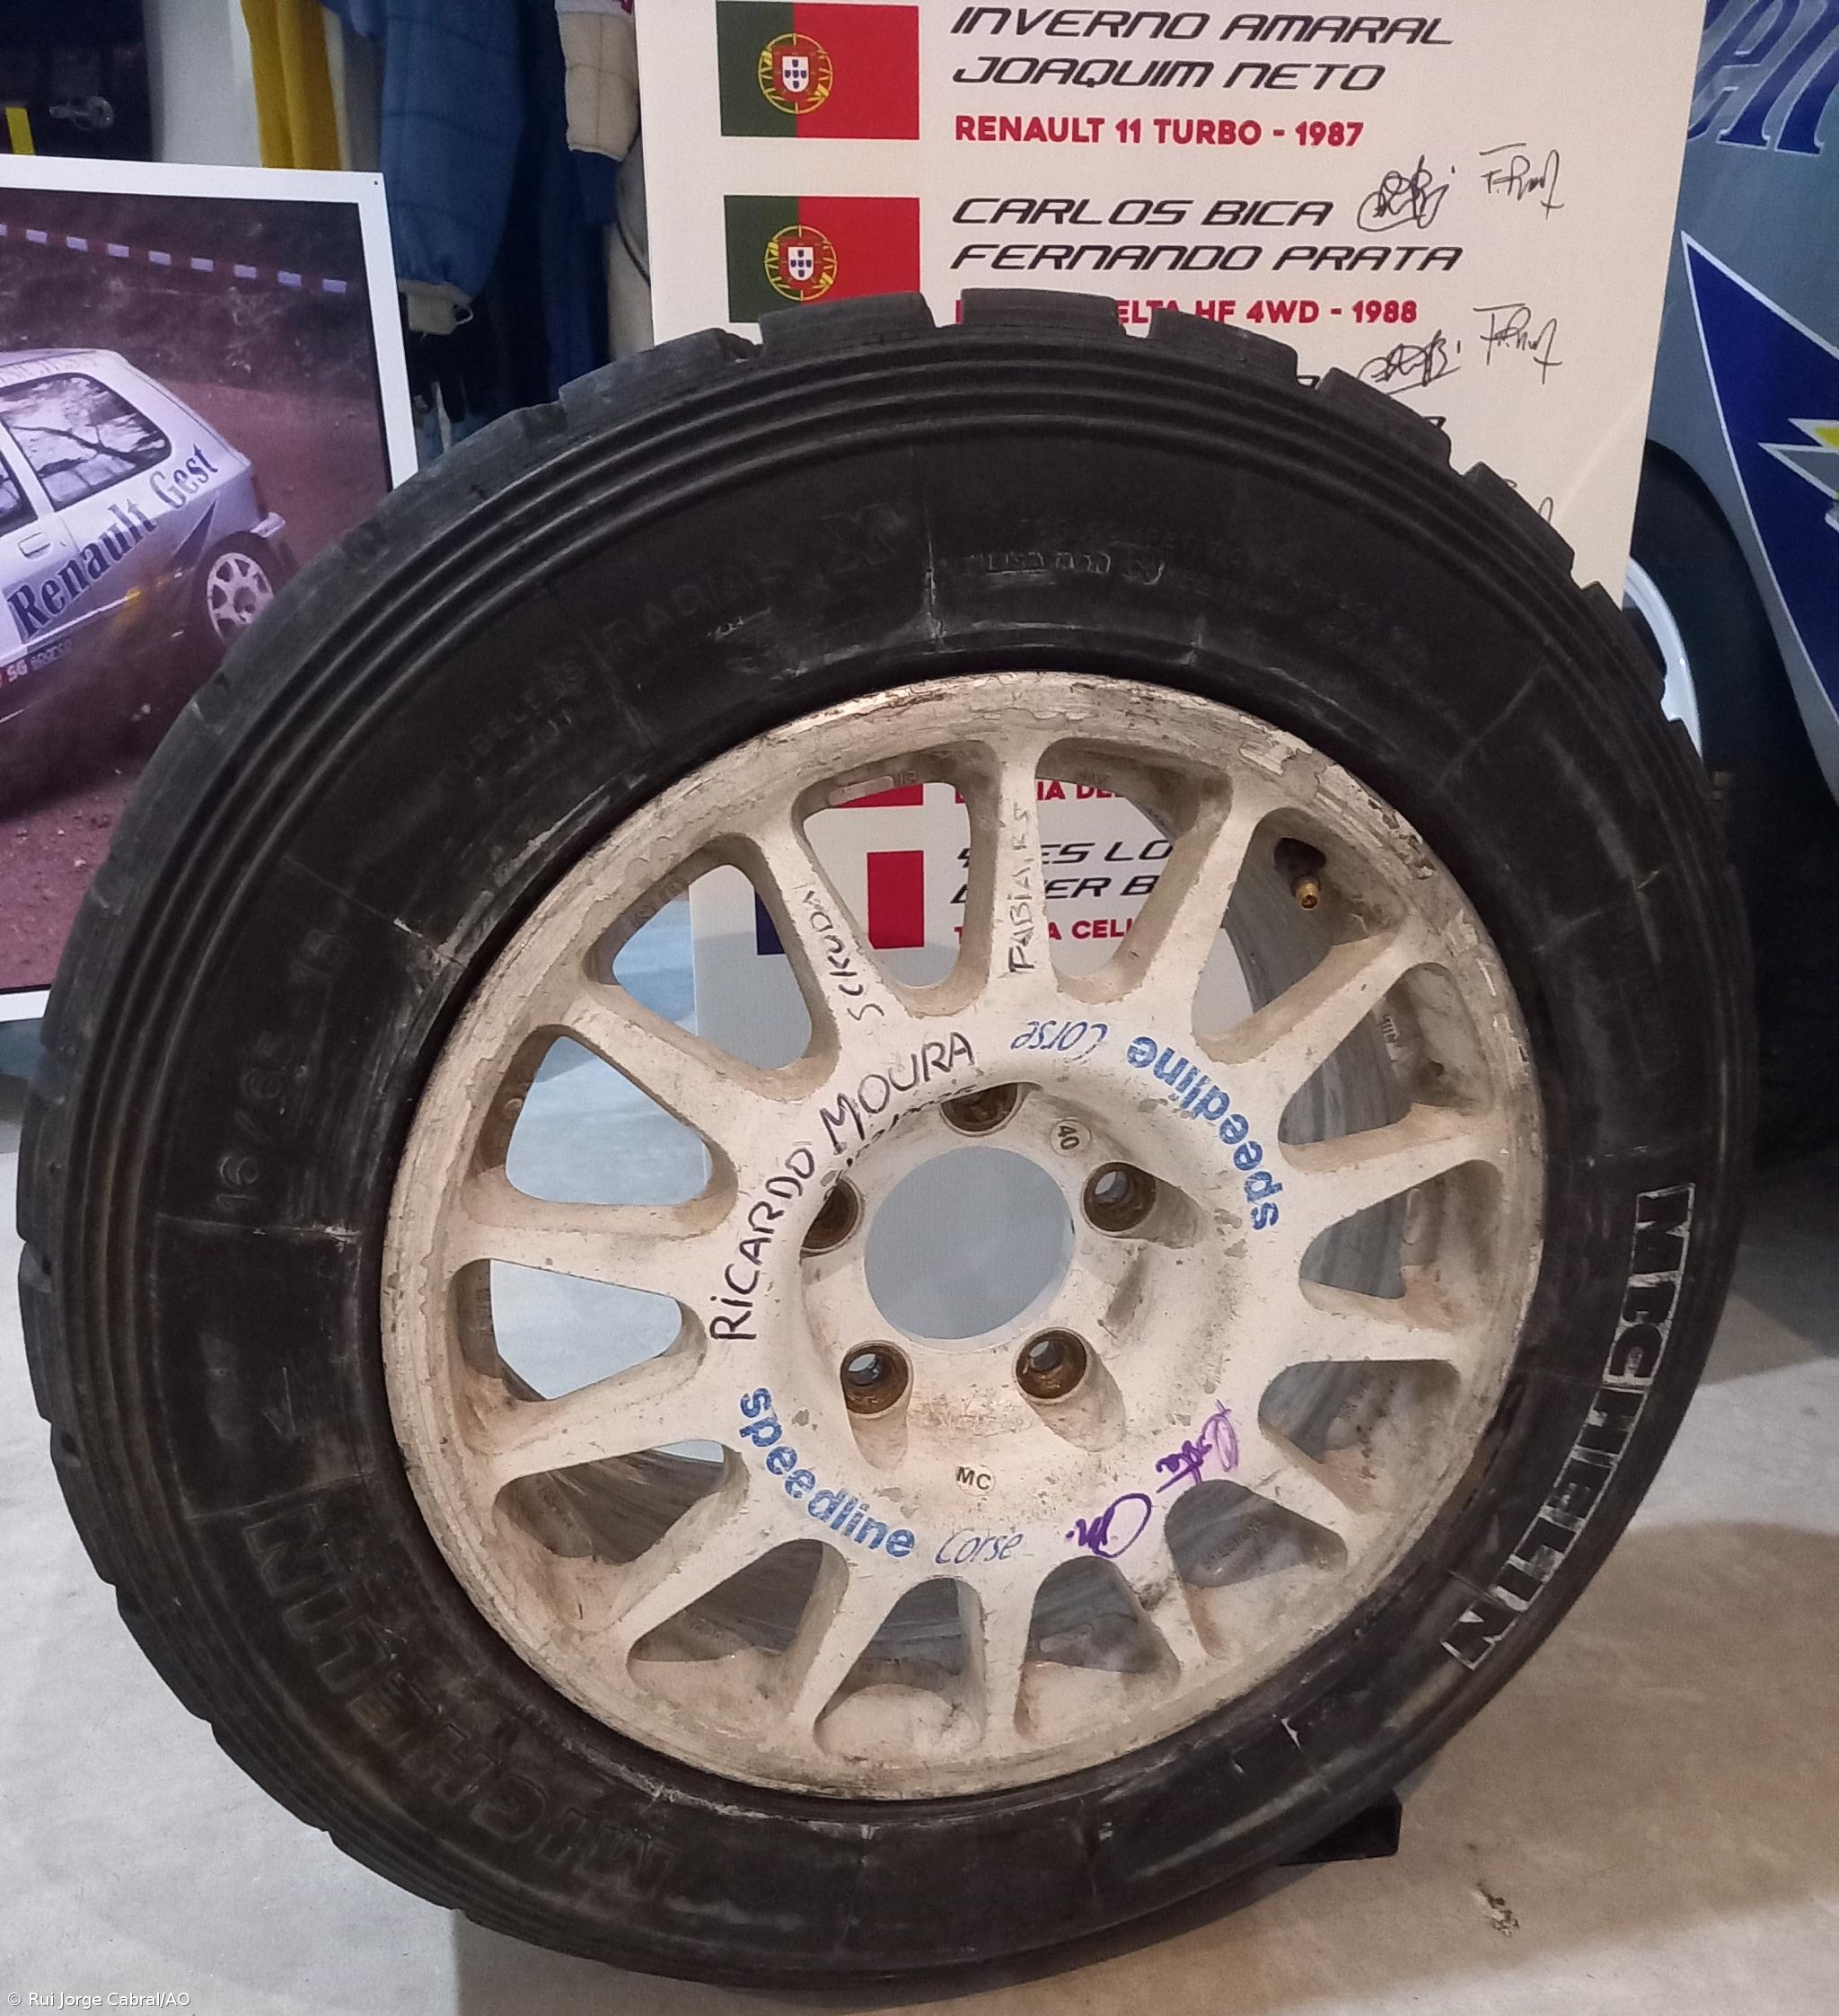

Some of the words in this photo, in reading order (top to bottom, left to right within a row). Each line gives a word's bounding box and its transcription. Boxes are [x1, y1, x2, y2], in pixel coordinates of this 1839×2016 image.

[950, 6, 1210, 40] INVERNO
[1219, 13, 1454, 45] AMARAL
[952, 57, 1214, 90] JOAQUIM
[1222, 64, 1386, 91] NETO
[955, 115, 1104, 144] RENAULT
[1115, 119, 1142, 144] 11
[1153, 119, 1263, 145] TURBO
[1295, 121, 1365, 147] 1987
[952, 198, 1193, 226] CARLOS
[1200, 199, 1334, 226] BICA
[950, 244, 1263, 271] FERNANDO
[1271, 246, 1464, 271] PRATA
[1245, 300, 1320, 324] 4WD
[1351, 300, 1418, 324] 1988
[6, 498, 157, 638] Renault
[149, 444, 219, 509] Gest
[1009, 1020, 1109, 1062] Corse
[818, 1030, 976, 1155] MOURA
[1056, 1124, 1080, 1150] 40
[1126, 1034, 1283, 1231] speedline
[1439, 1181, 1695, 1670] MICHELIN
[740, 1387, 916, 1558] speedline
[934, 1528, 1025, 1565] Corse
[955, 1466, 992, 1492] MC
